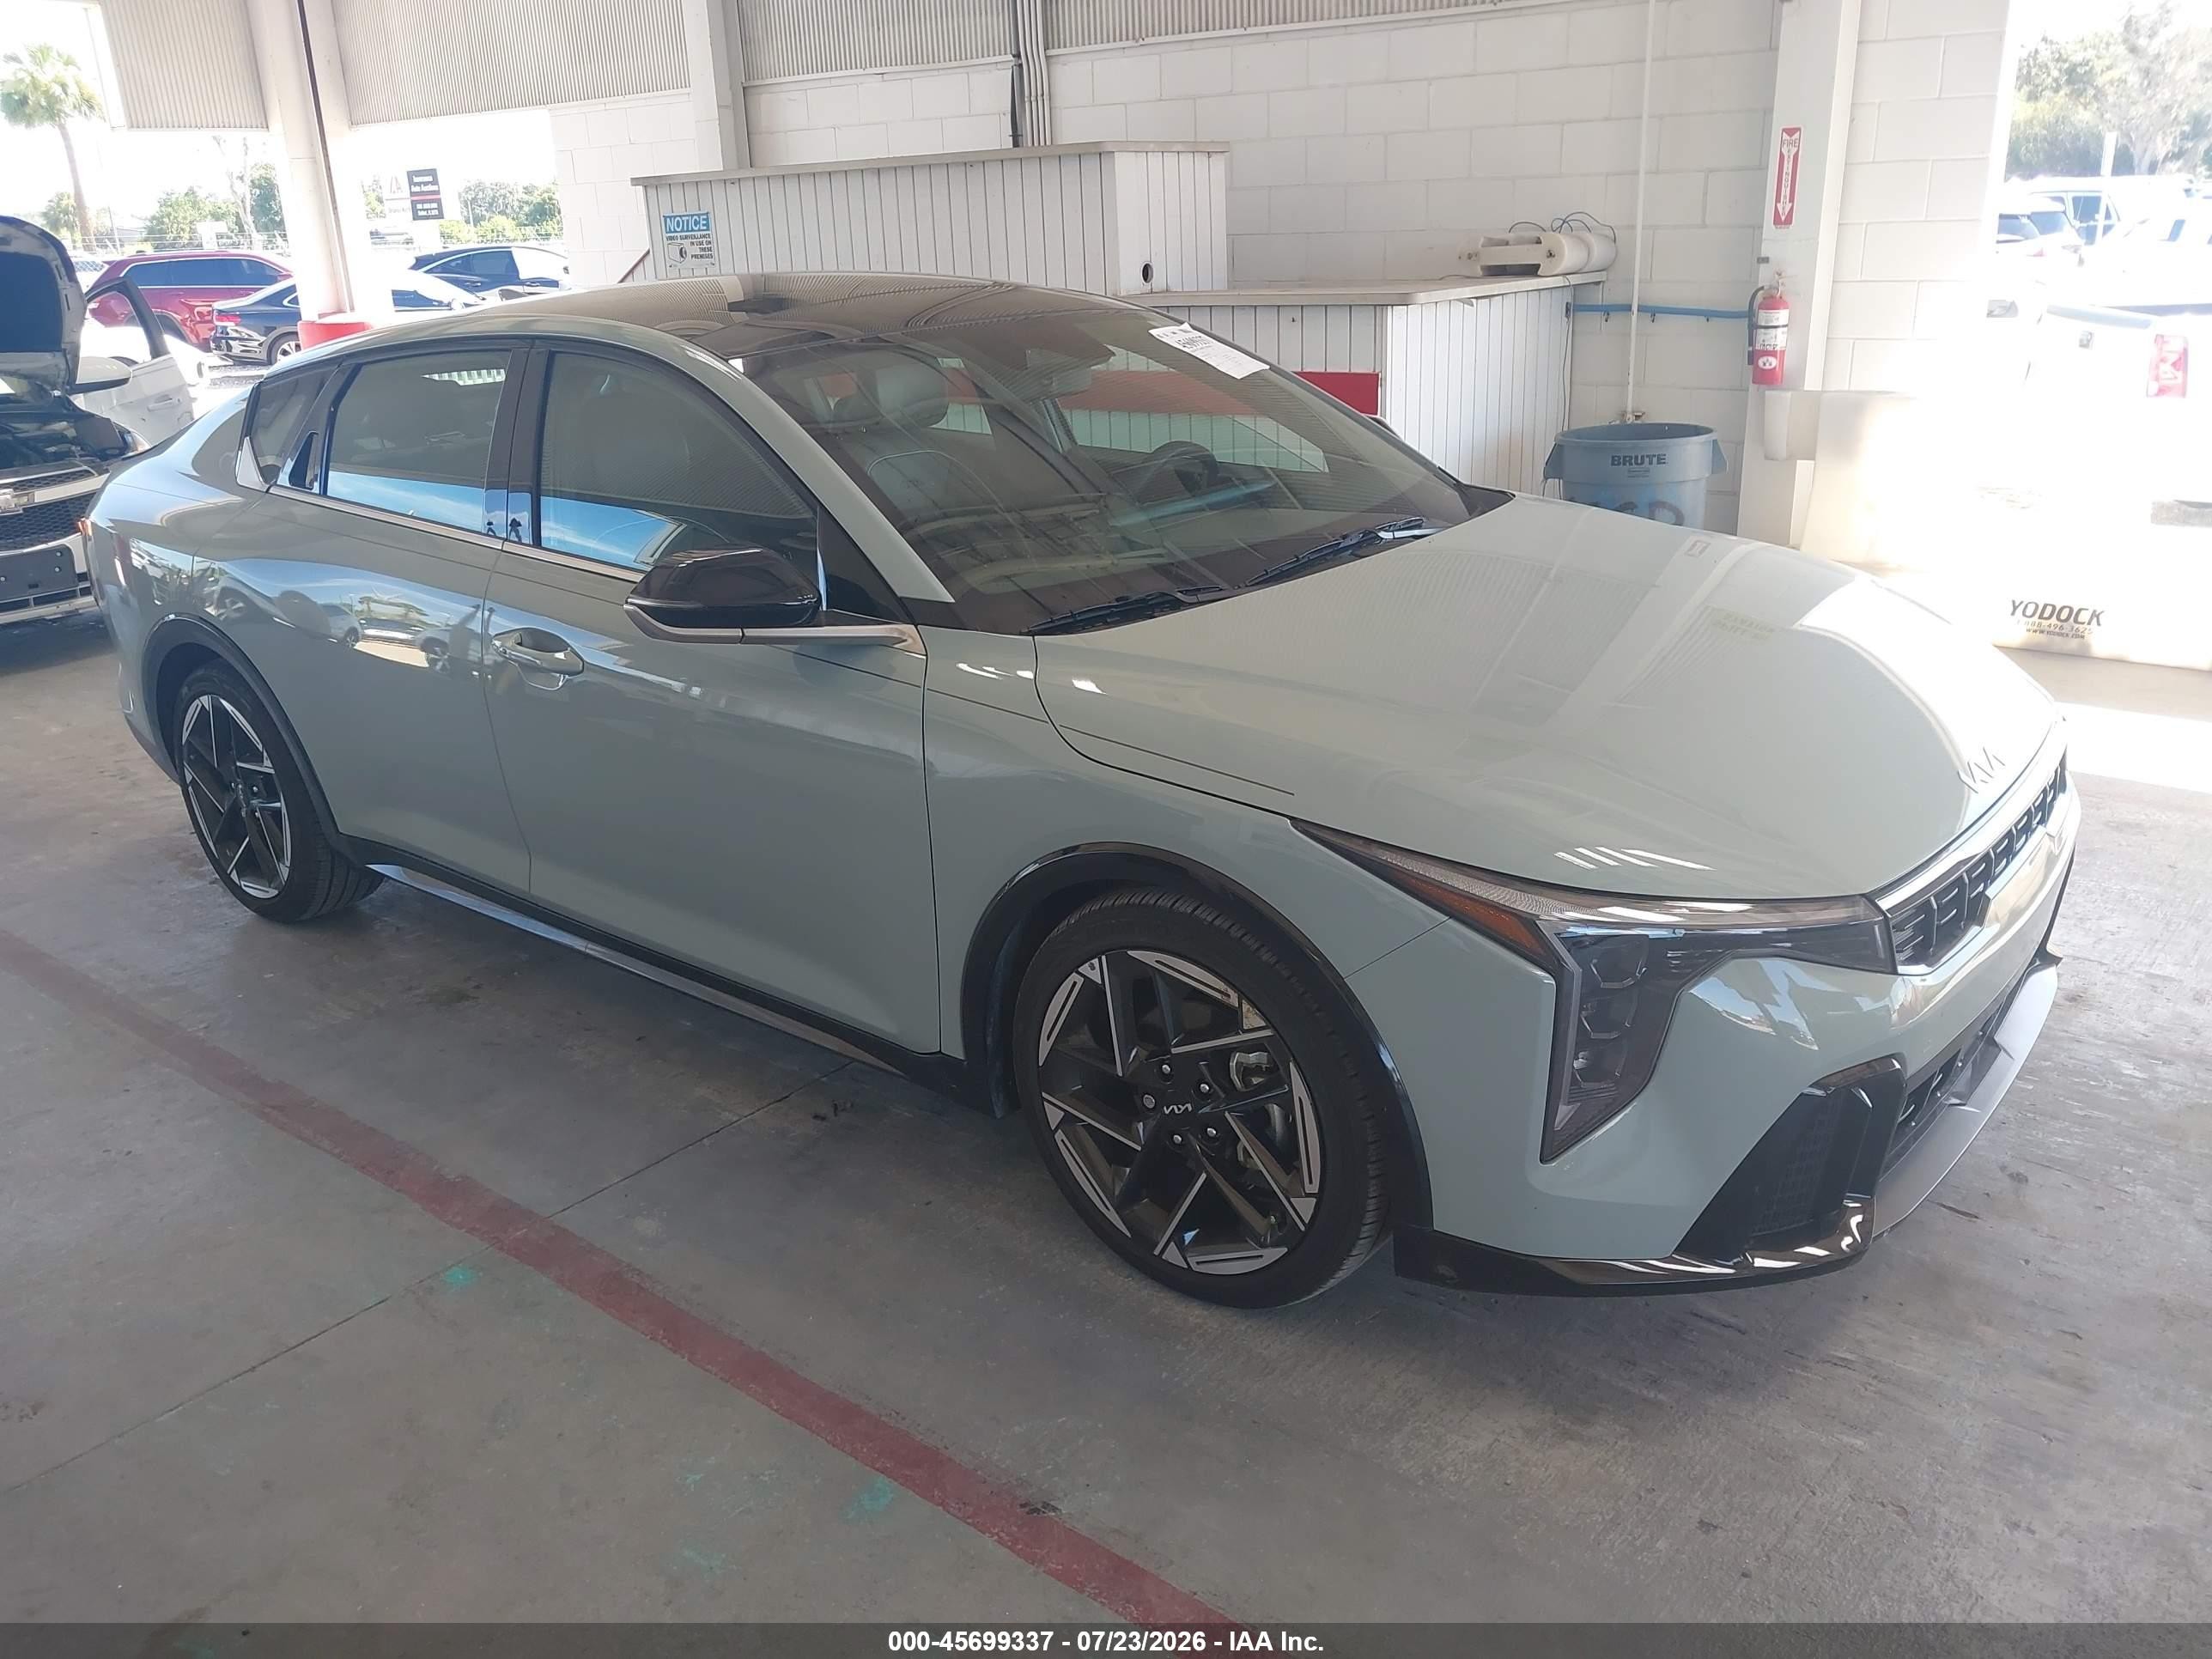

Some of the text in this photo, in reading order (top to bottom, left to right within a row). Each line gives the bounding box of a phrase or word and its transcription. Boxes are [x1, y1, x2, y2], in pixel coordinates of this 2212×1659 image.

[1782, 137, 1799, 149] FIRE
[665, 215, 708, 233] NOTICE
[679, 233, 711, 241] SURVEILLANCE
[1610, 453, 1667, 467] BRUTE
[2010, 599, 2105, 627] YODOCK
